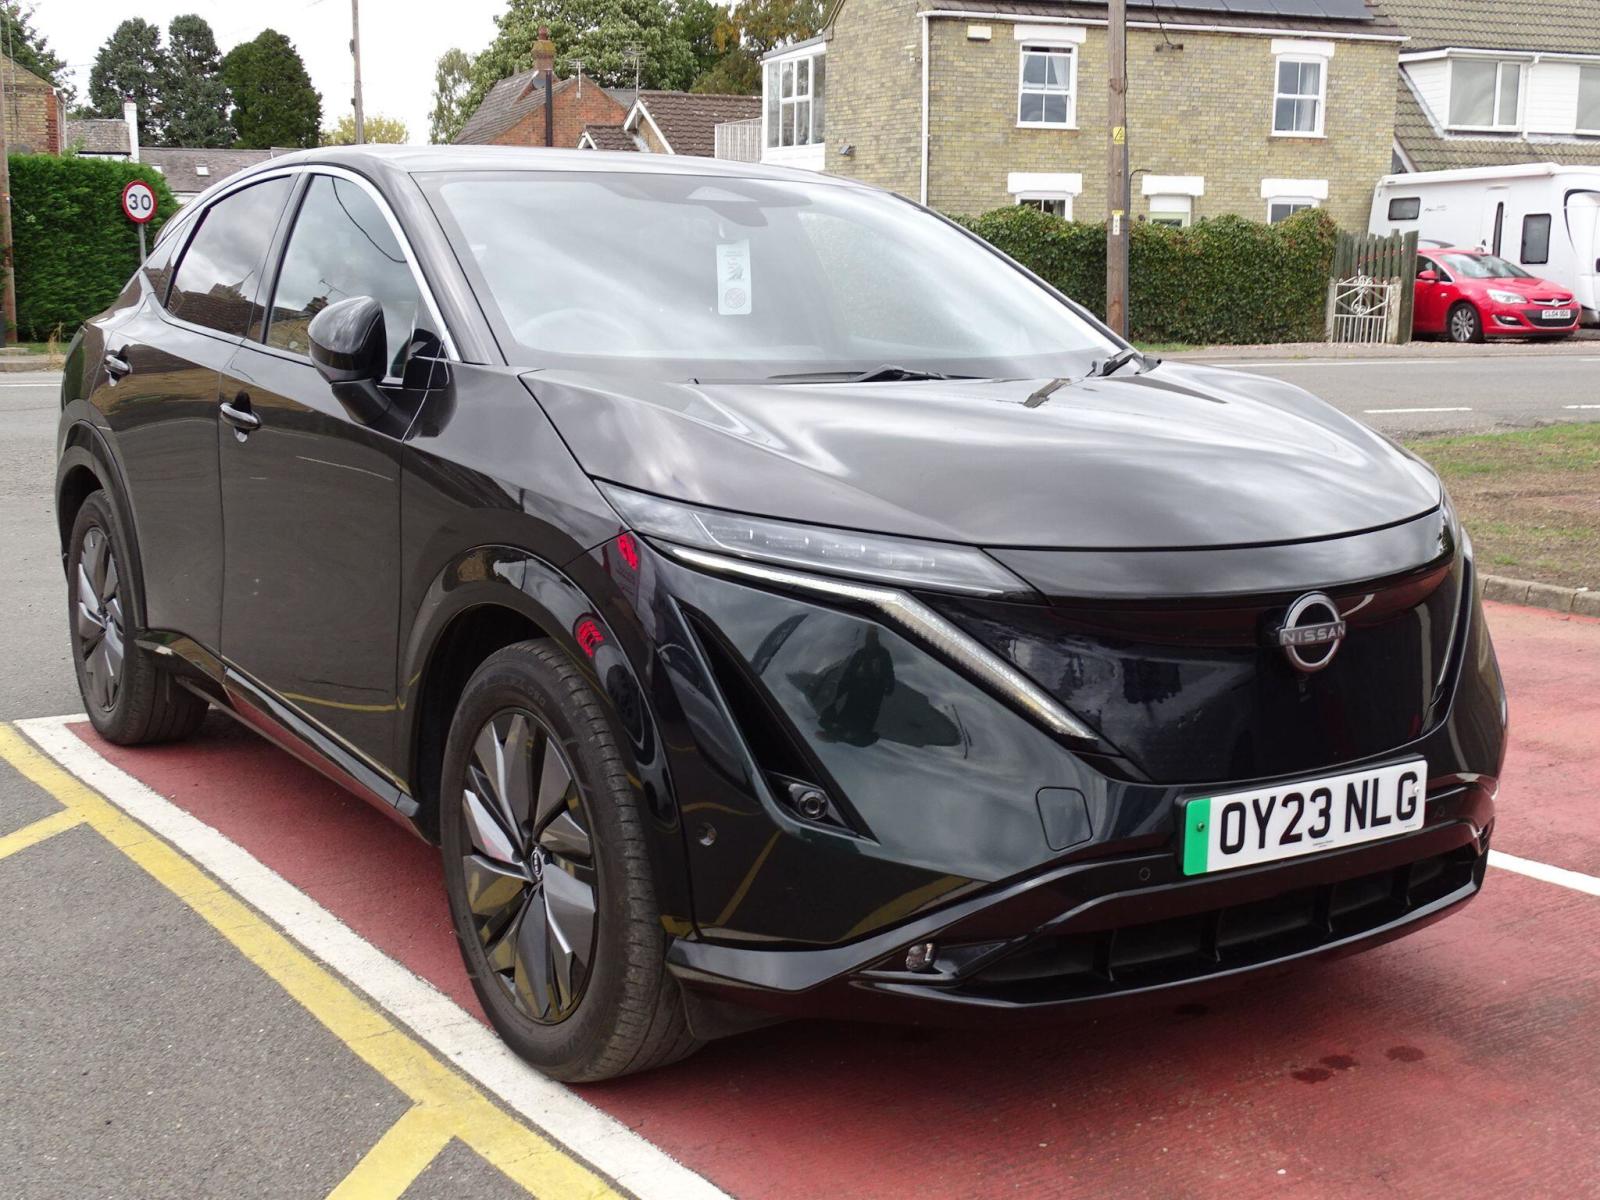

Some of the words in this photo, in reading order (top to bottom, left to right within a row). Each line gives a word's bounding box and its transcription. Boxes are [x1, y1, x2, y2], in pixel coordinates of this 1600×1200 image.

[129, 193, 151, 210] 30
[1282, 624, 1345, 643] NISSAN
[1219, 787, 1333, 855] OY23
[1344, 771, 1418, 833] NLG
